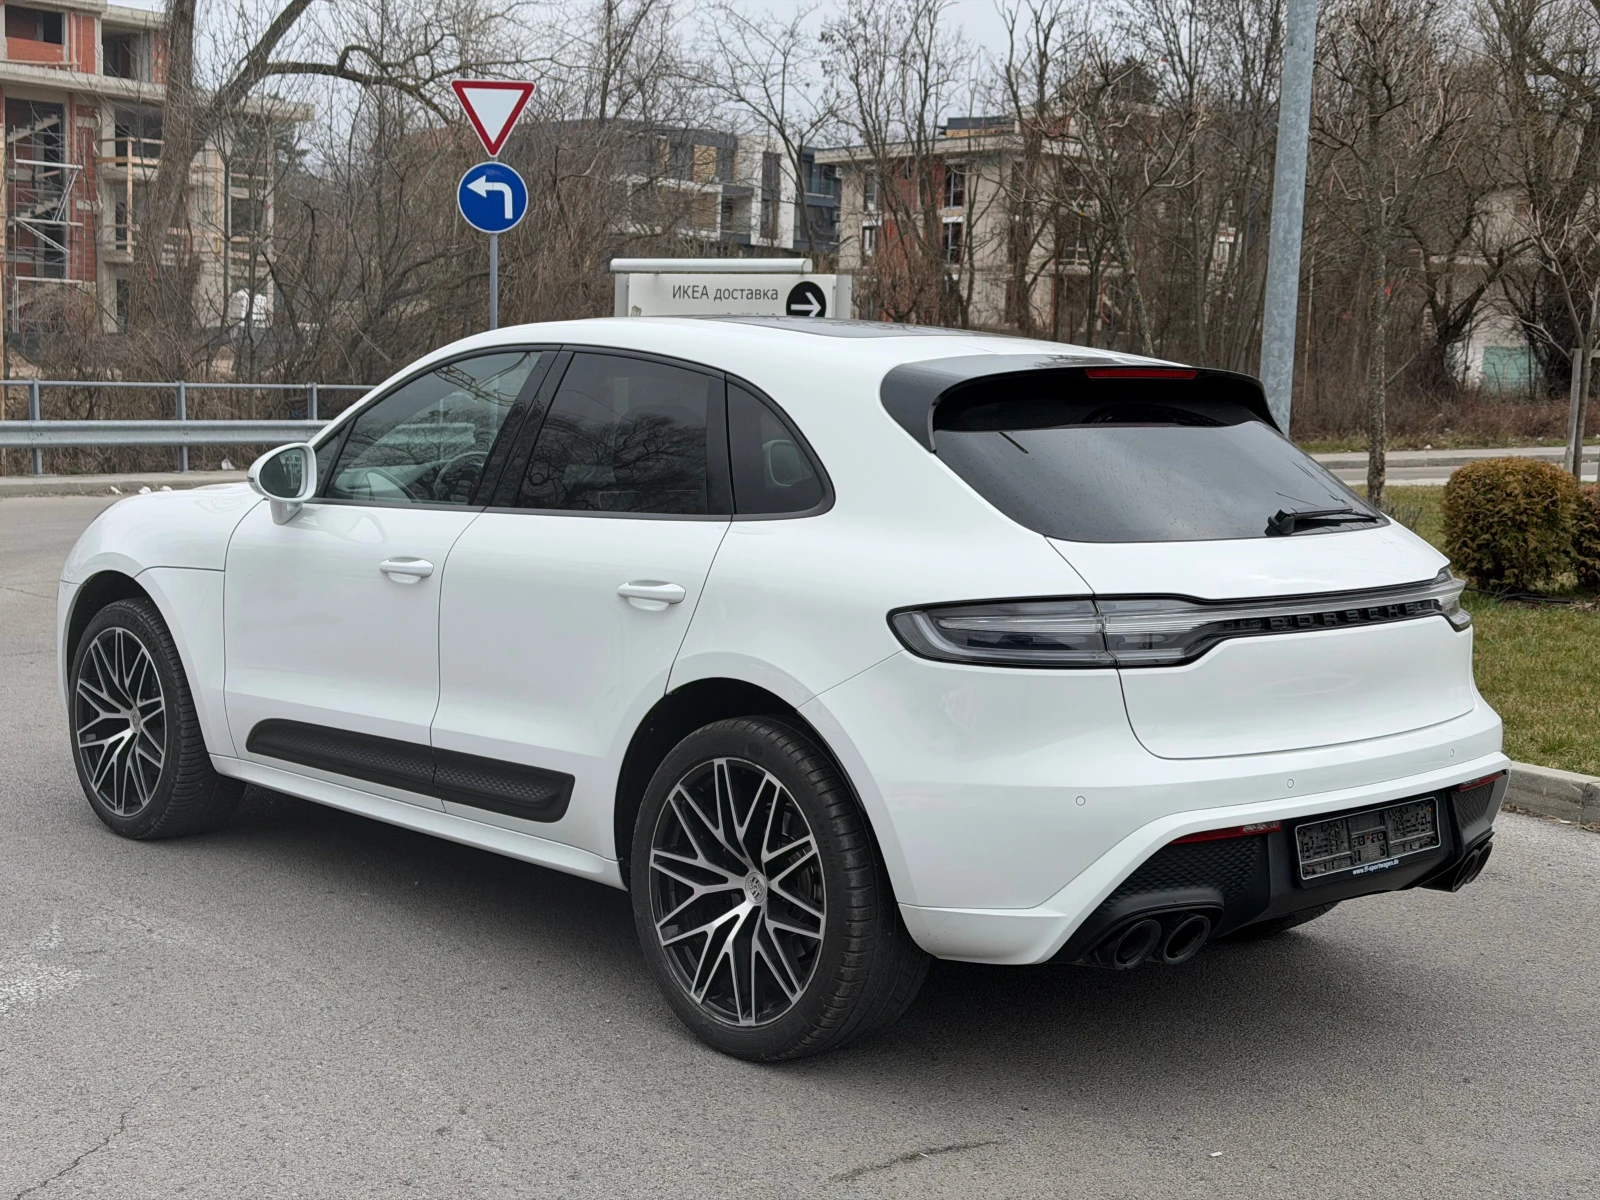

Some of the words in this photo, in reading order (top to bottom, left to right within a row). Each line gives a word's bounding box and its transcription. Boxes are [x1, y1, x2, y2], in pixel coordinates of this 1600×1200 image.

[672, 285, 709, 299] ИКЕА
[713, 288, 779, 302] доставка
[1270, 603, 1416, 629] PORSCHE
